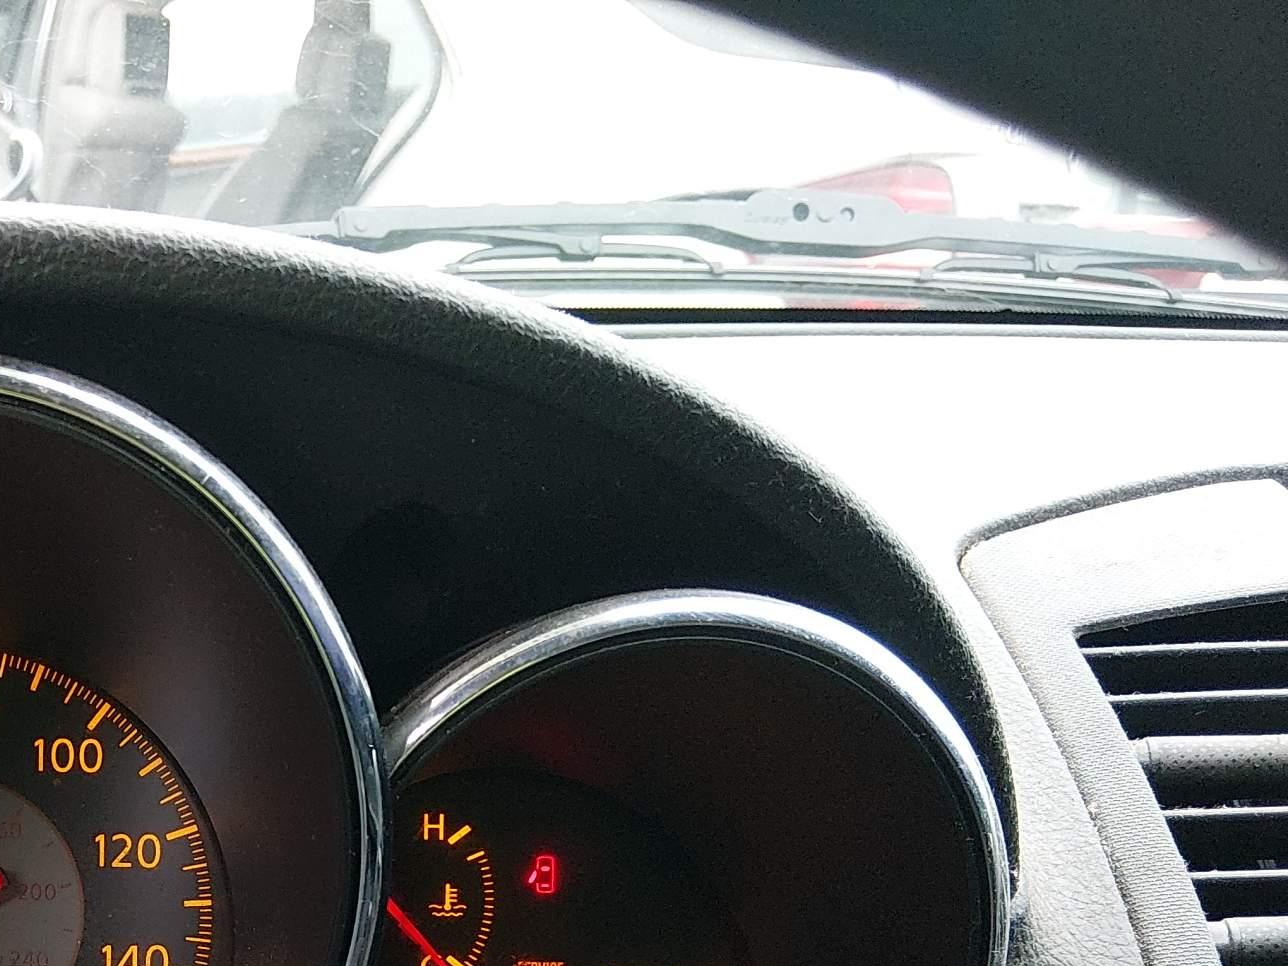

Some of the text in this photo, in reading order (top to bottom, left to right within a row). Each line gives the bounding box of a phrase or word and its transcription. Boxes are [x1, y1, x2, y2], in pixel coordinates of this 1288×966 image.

[33, 738, 104, 773] 100
[423, 813, 445, 841] H
[94, 834, 162, 868] 120
